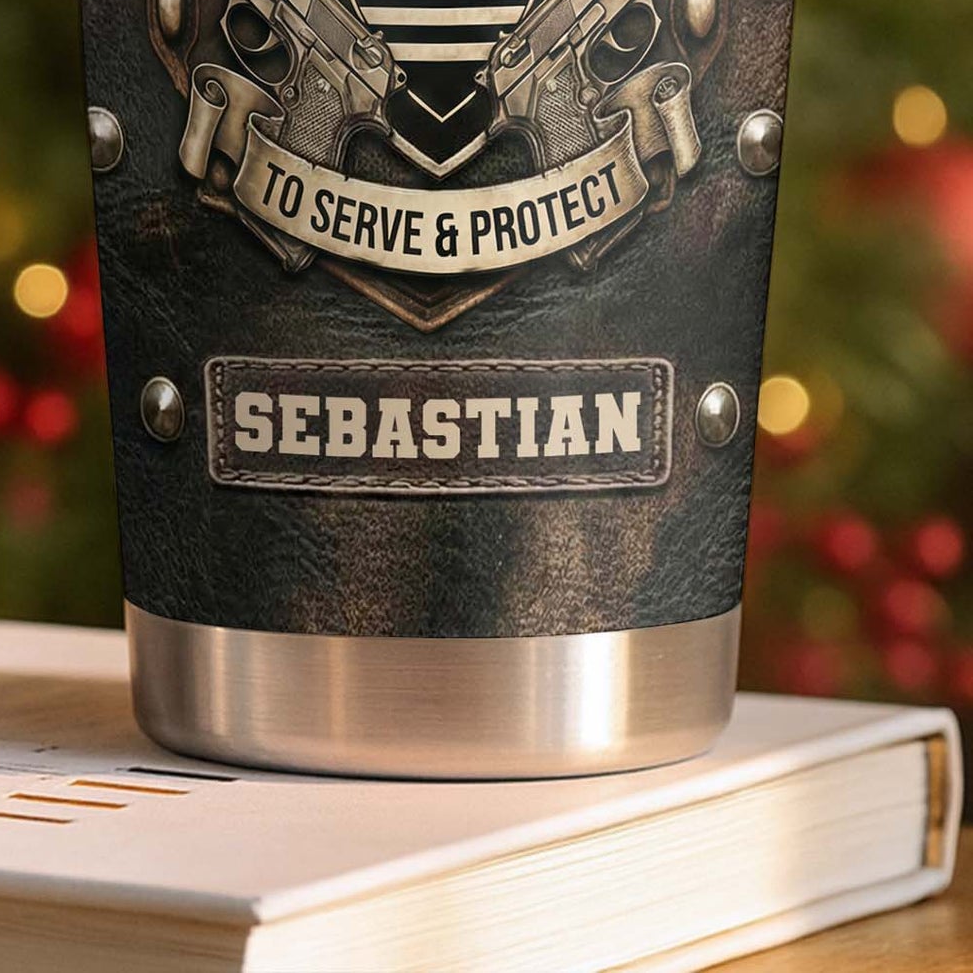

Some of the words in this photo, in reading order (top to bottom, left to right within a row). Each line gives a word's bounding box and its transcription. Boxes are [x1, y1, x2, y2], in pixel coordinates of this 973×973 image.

[263, 161, 304, 218] TO
[310, 189, 424, 256] SERVE
[435, 213, 458, 257] &
[471, 162, 623, 254] PROTECT
[235, 391, 641, 459] SEBASTIAN
